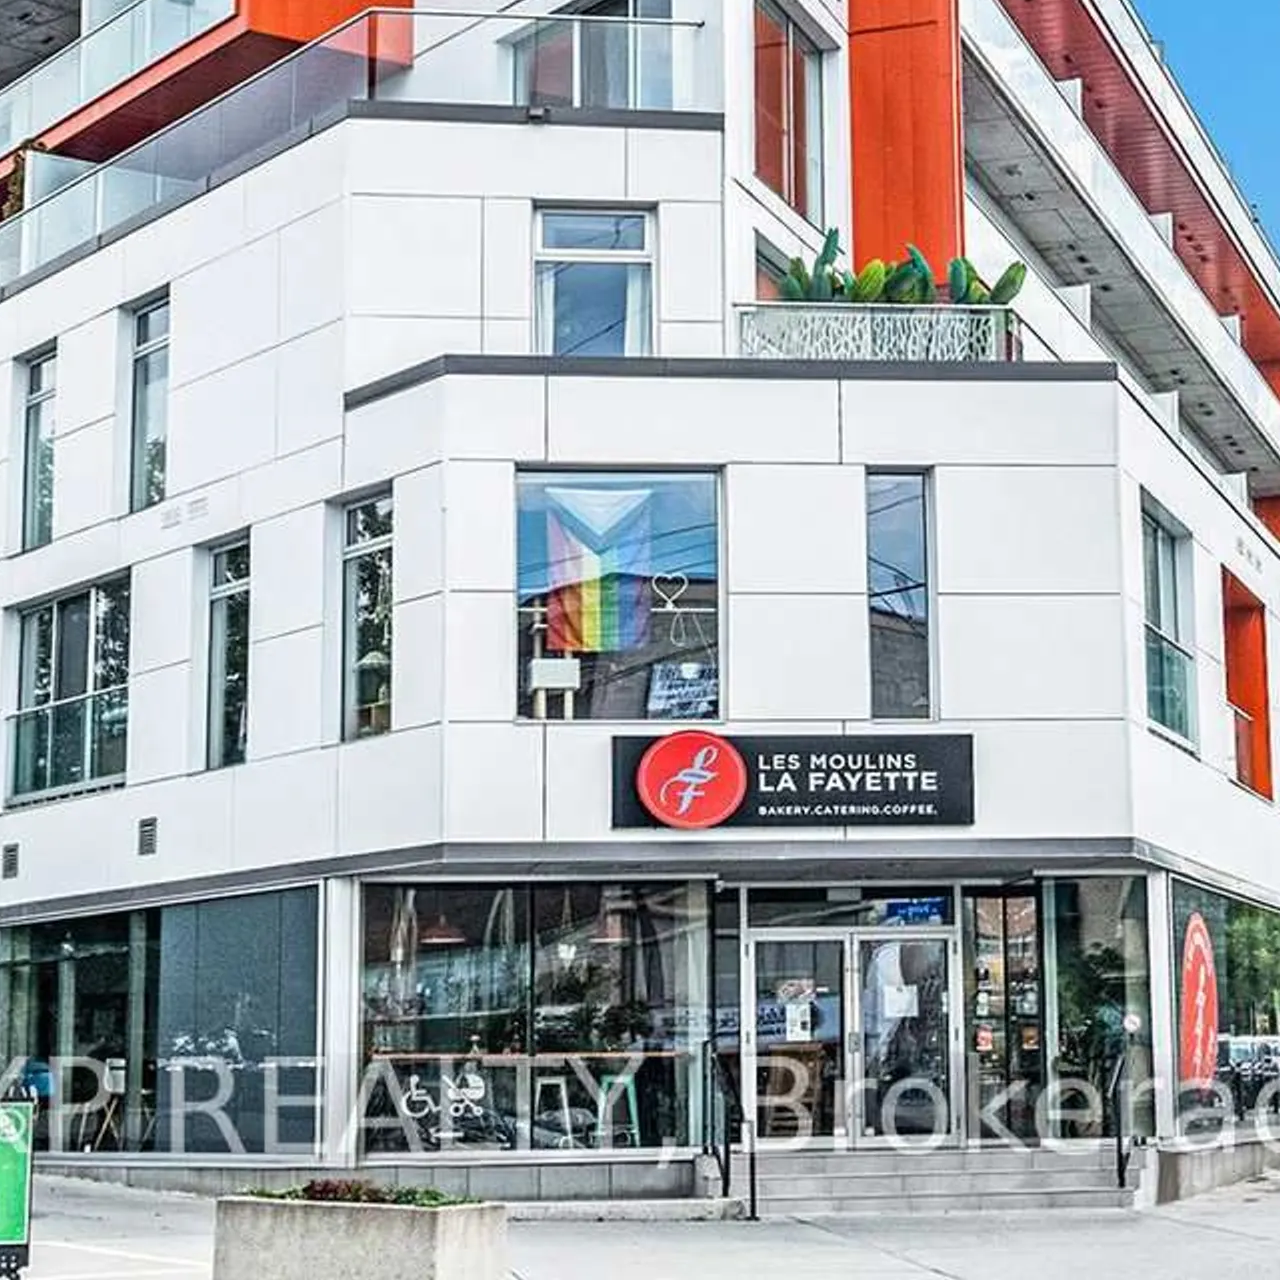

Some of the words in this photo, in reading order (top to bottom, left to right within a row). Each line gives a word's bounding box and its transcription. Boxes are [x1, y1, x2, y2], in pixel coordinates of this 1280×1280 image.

[758, 754, 800, 770] LES
[810, 754, 917, 770] MOULINS
[758, 772, 798, 792] LA
[808, 771, 938, 792] FAYETTE
